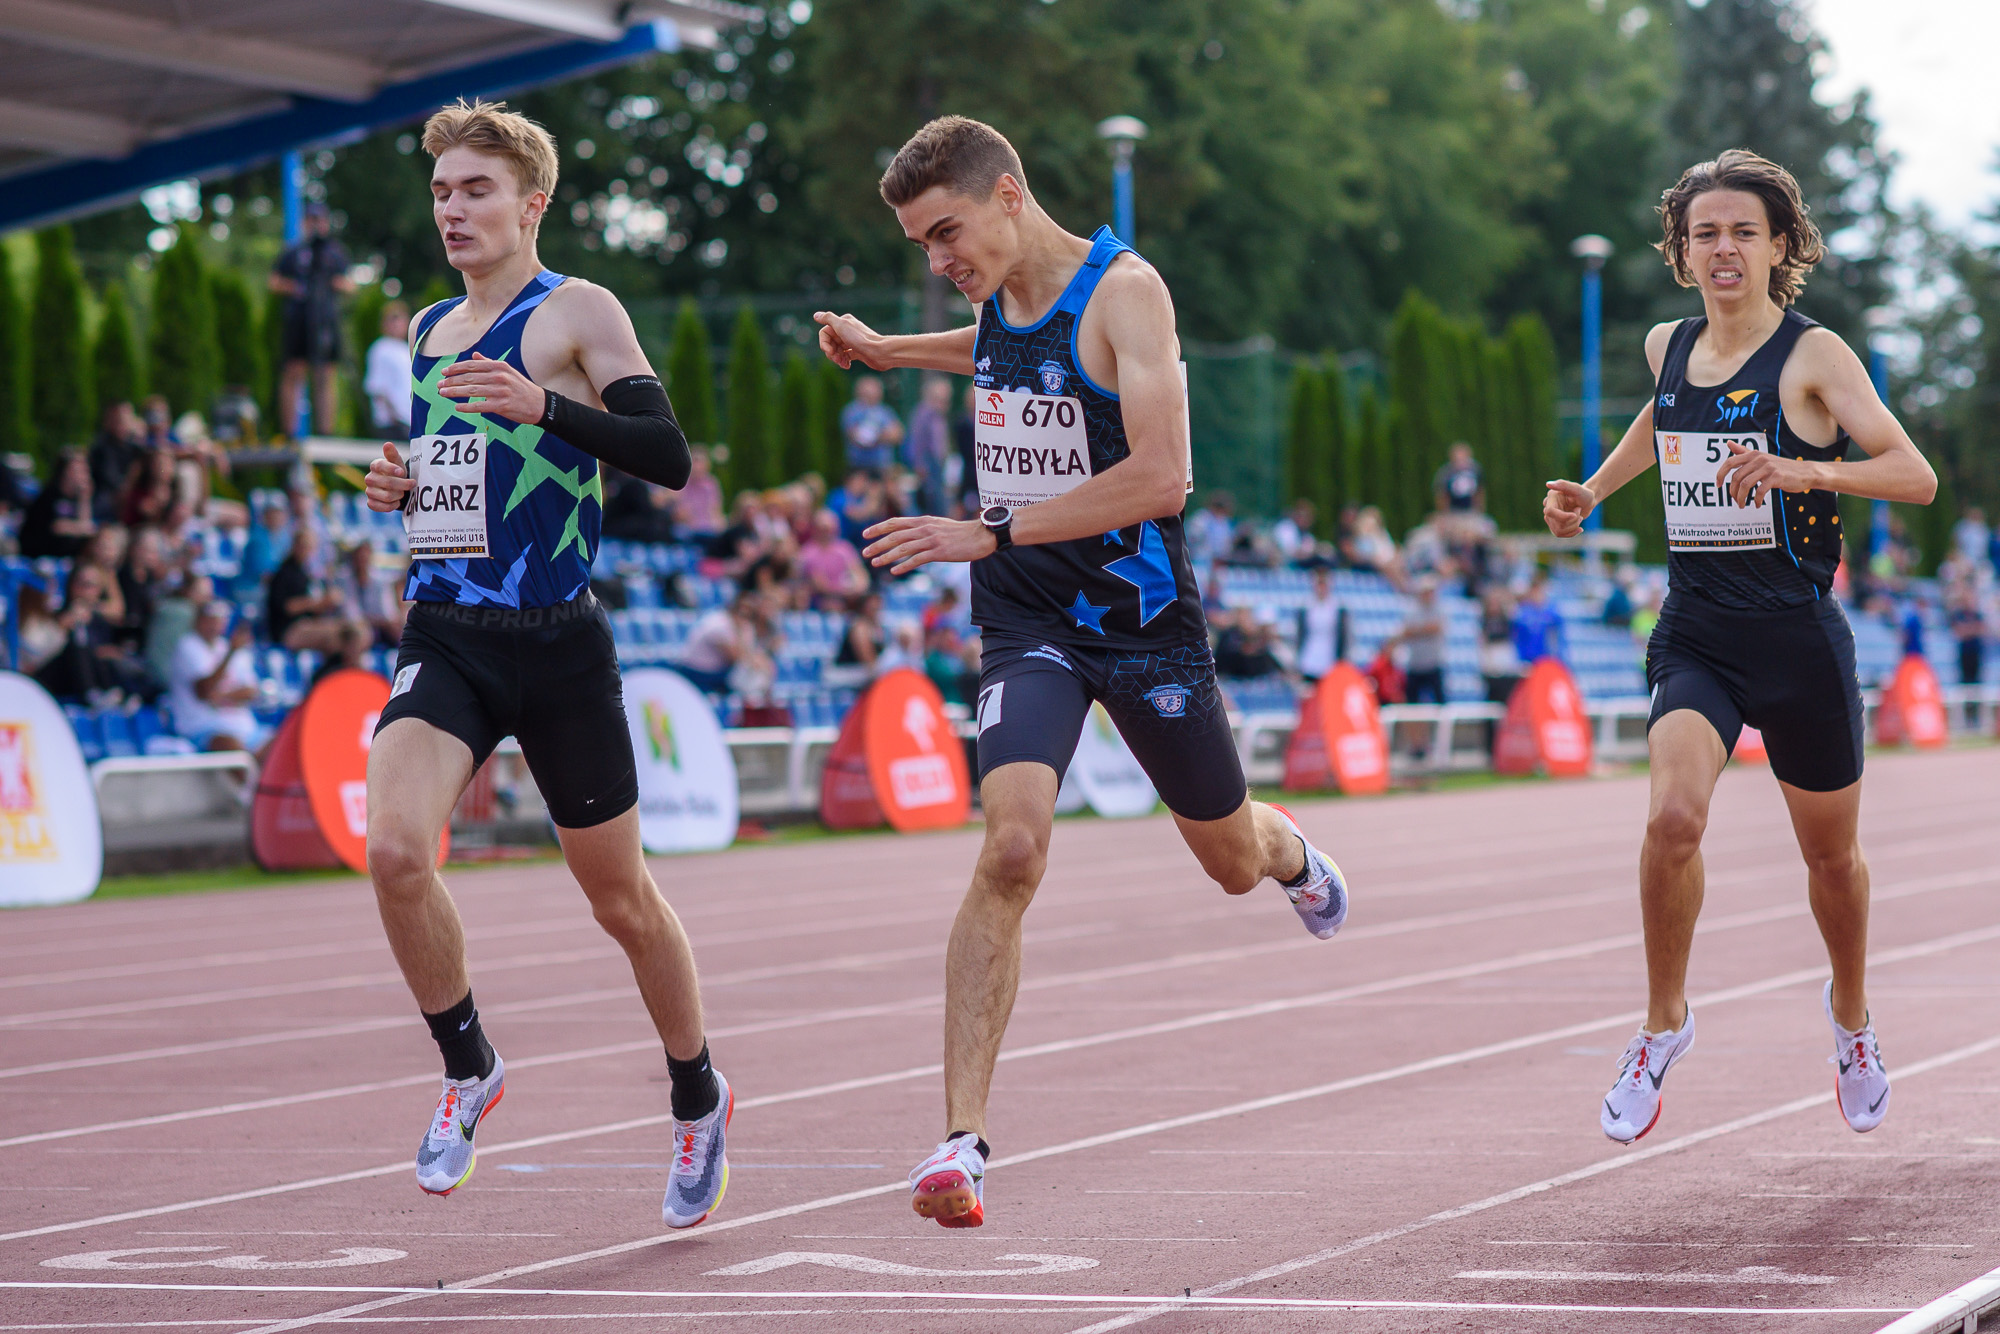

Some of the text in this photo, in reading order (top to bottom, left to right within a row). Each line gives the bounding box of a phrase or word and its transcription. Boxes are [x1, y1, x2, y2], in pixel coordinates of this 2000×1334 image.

[979, 412, 1003, 425] ORLEN
[1021, 399, 1076, 428] 670
[1714, 392, 1760, 429] Sopot
[429, 438, 480, 466] 216
[976, 441, 1087, 476] PRZYBYŁA
[993, 497, 1044, 508] Mistrzostw
[444, 534, 467, 543] Polski
[468, 533, 485, 542] U18
[1678, 528, 1725, 537] Mistrzostwa
[1728, 527, 1753, 536] Polski
[1755, 526, 1772, 535] U18
[481, 608, 543, 628] PRO
